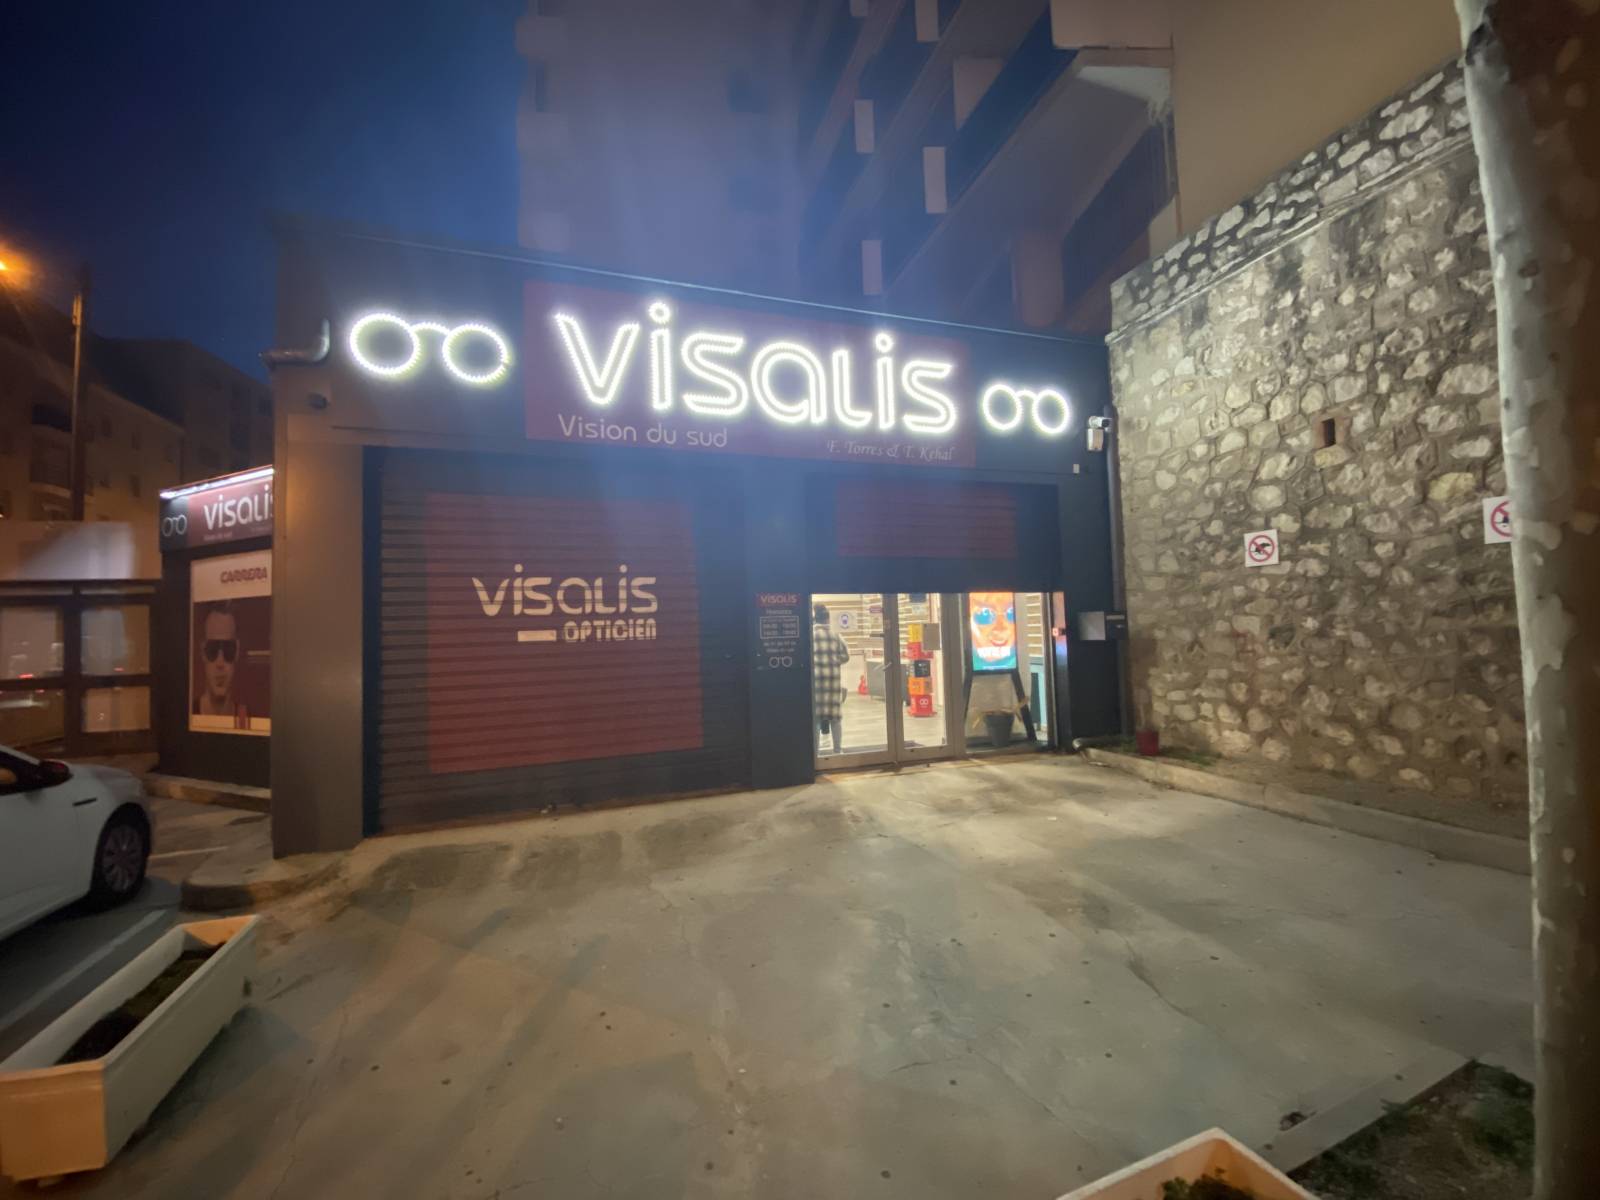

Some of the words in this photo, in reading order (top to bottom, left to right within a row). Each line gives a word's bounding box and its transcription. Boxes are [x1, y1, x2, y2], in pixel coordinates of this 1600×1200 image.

[557, 413, 638, 442] Vision
[646, 423, 677, 446] du
[686, 427, 728, 449] sud
